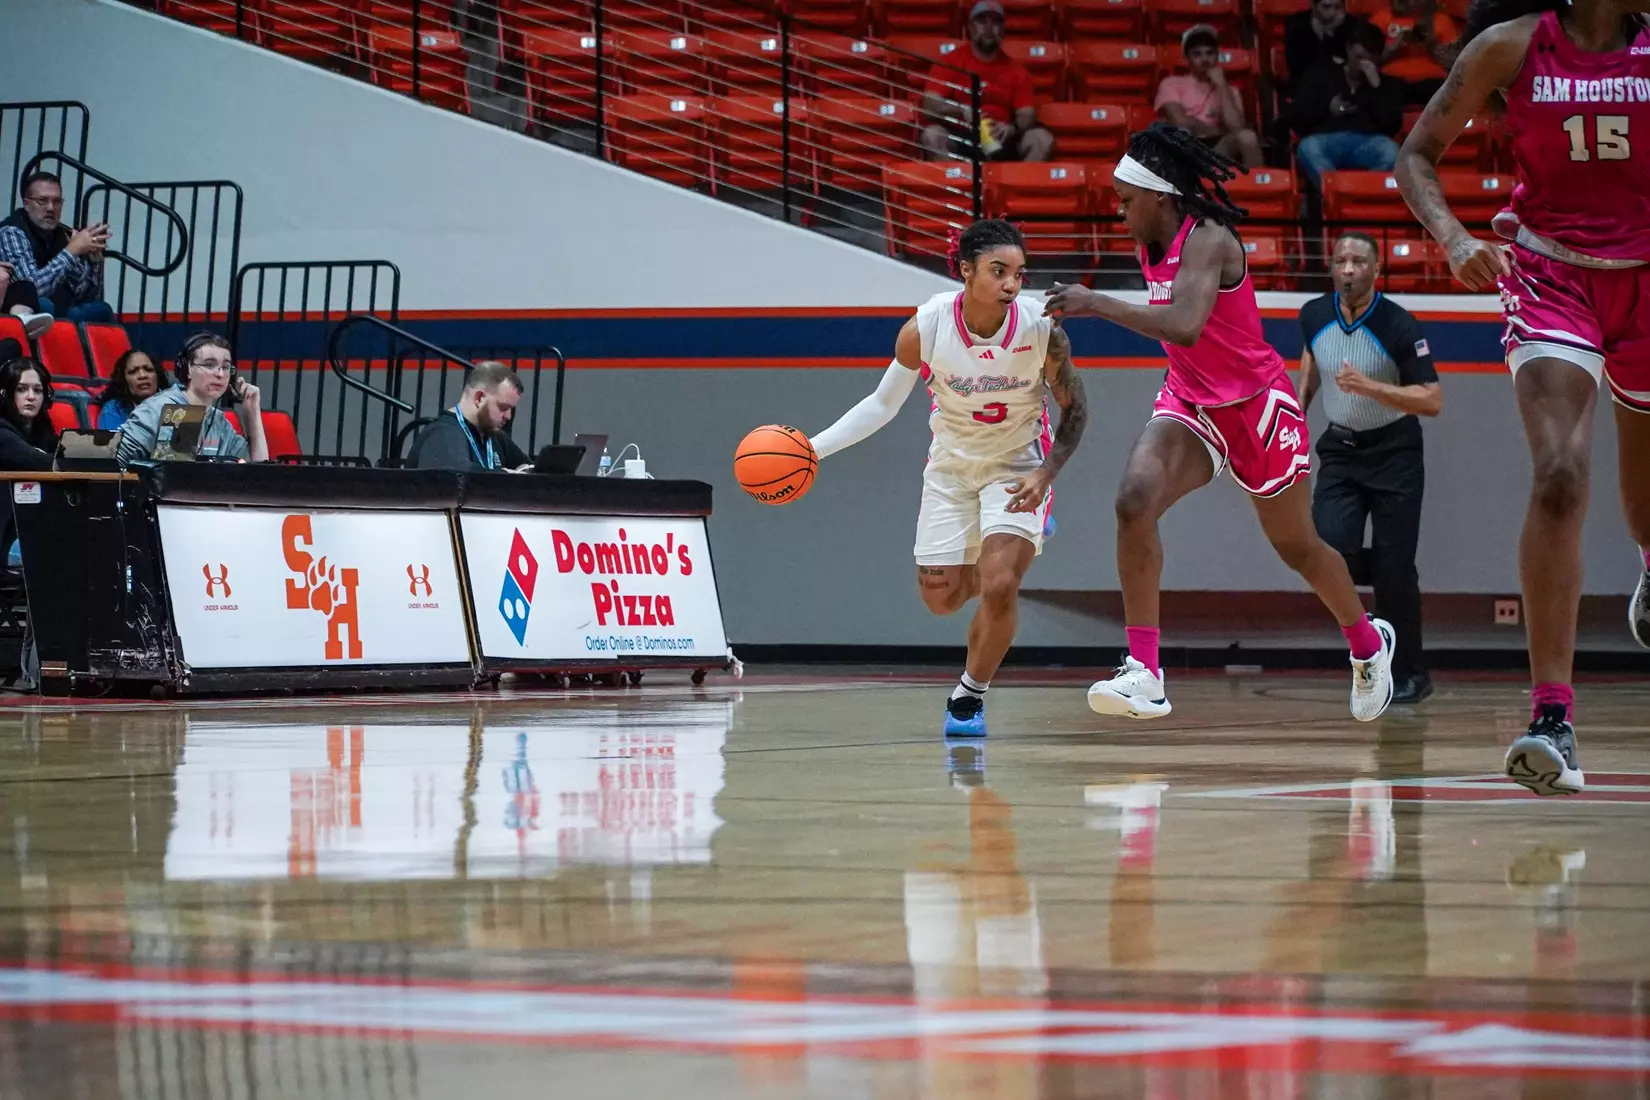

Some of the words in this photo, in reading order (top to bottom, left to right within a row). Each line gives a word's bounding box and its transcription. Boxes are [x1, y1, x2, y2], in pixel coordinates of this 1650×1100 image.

[1532, 75, 1571, 102] SAM
[1562, 114, 1631, 162] 15
[972, 401, 1008, 424] 3
[550, 527, 693, 576] Domino's
[591, 579, 675, 627] Pizza
[585, 635, 608, 651] Order
[609, 635, 635, 651] Online
[636, 635, 643, 650] @
[643, 635, 695, 650] Dominos.com
